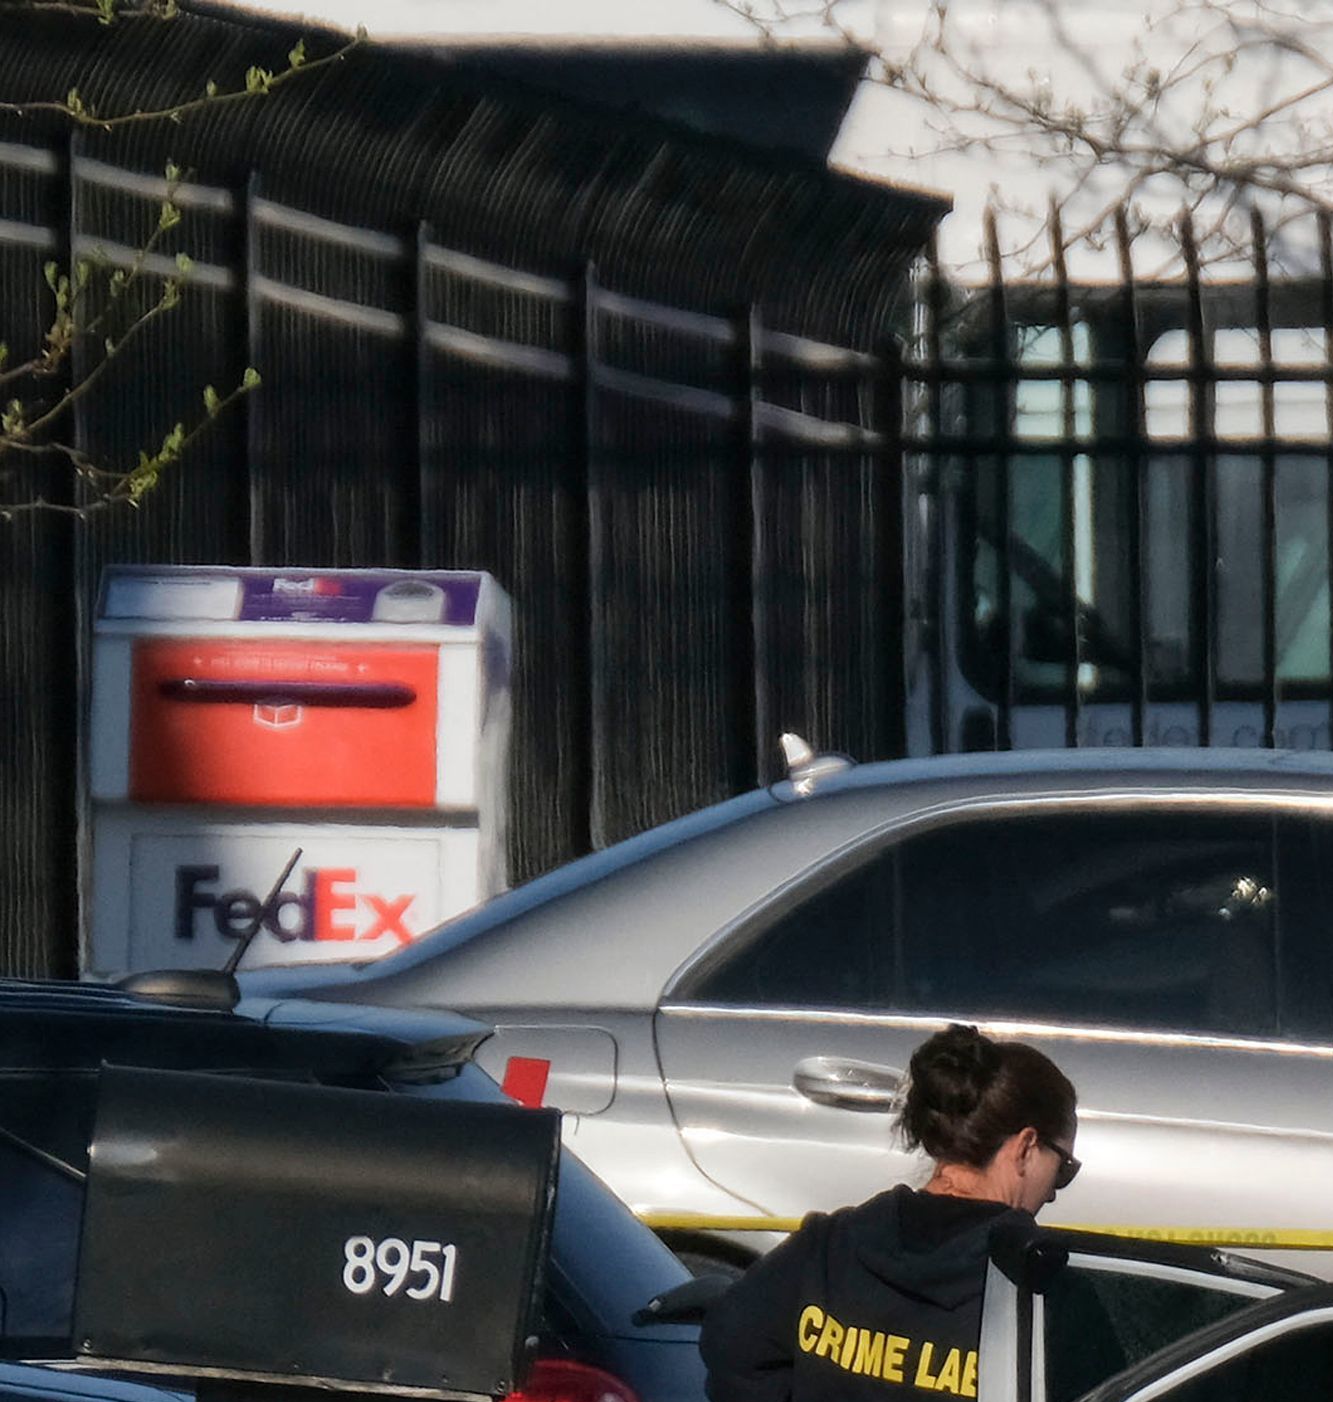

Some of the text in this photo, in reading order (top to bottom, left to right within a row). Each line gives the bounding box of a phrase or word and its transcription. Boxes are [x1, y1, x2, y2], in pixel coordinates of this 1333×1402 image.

[174, 864, 416, 949] FedEx
[343, 1236, 456, 1302] 8951
[798, 1305, 910, 1383] CRIME
